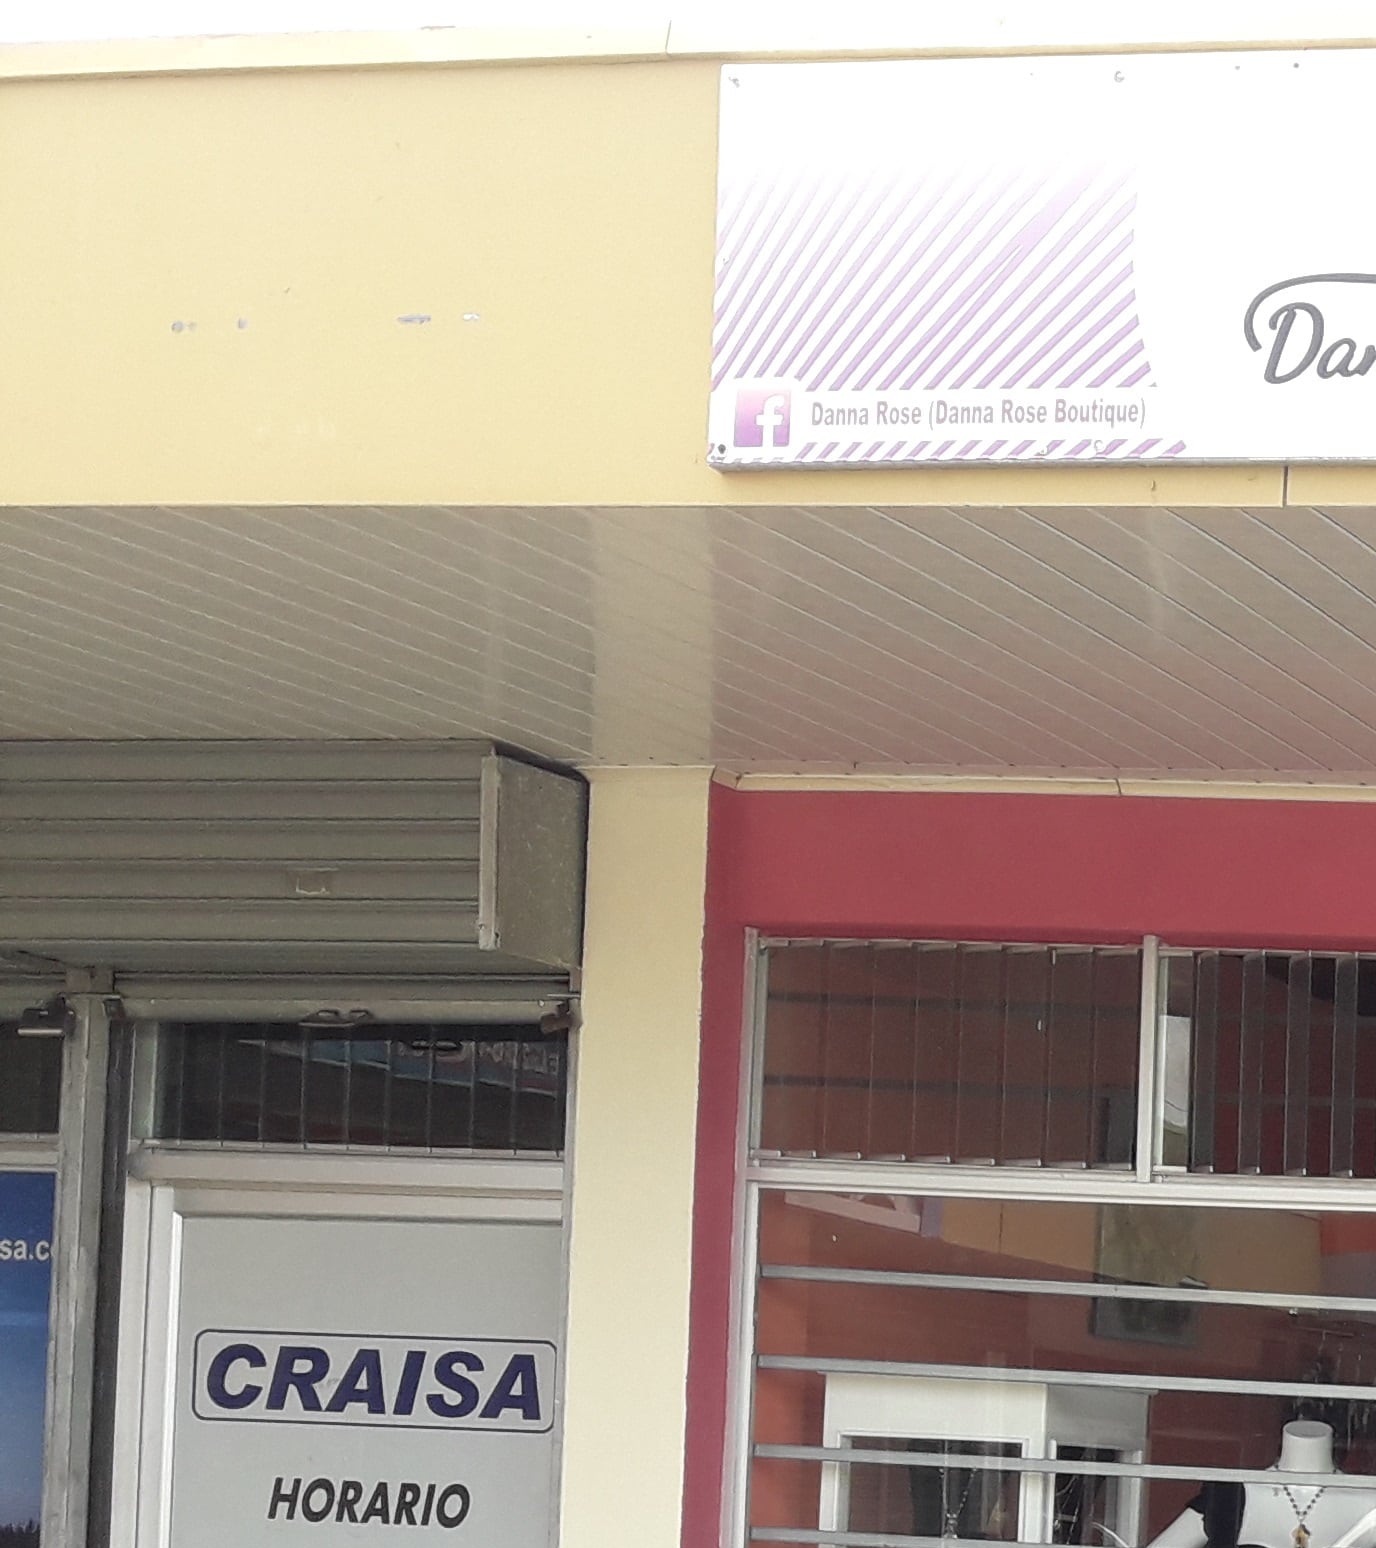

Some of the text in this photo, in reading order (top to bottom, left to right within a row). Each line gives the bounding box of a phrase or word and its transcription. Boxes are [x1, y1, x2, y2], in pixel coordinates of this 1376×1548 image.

[811, 398, 1146, 430] Danna Rose (Danna Rose Boutique)
[206, 1344, 542, 1420] CRAISA
[267, 1477, 470, 1529] HORARIO
